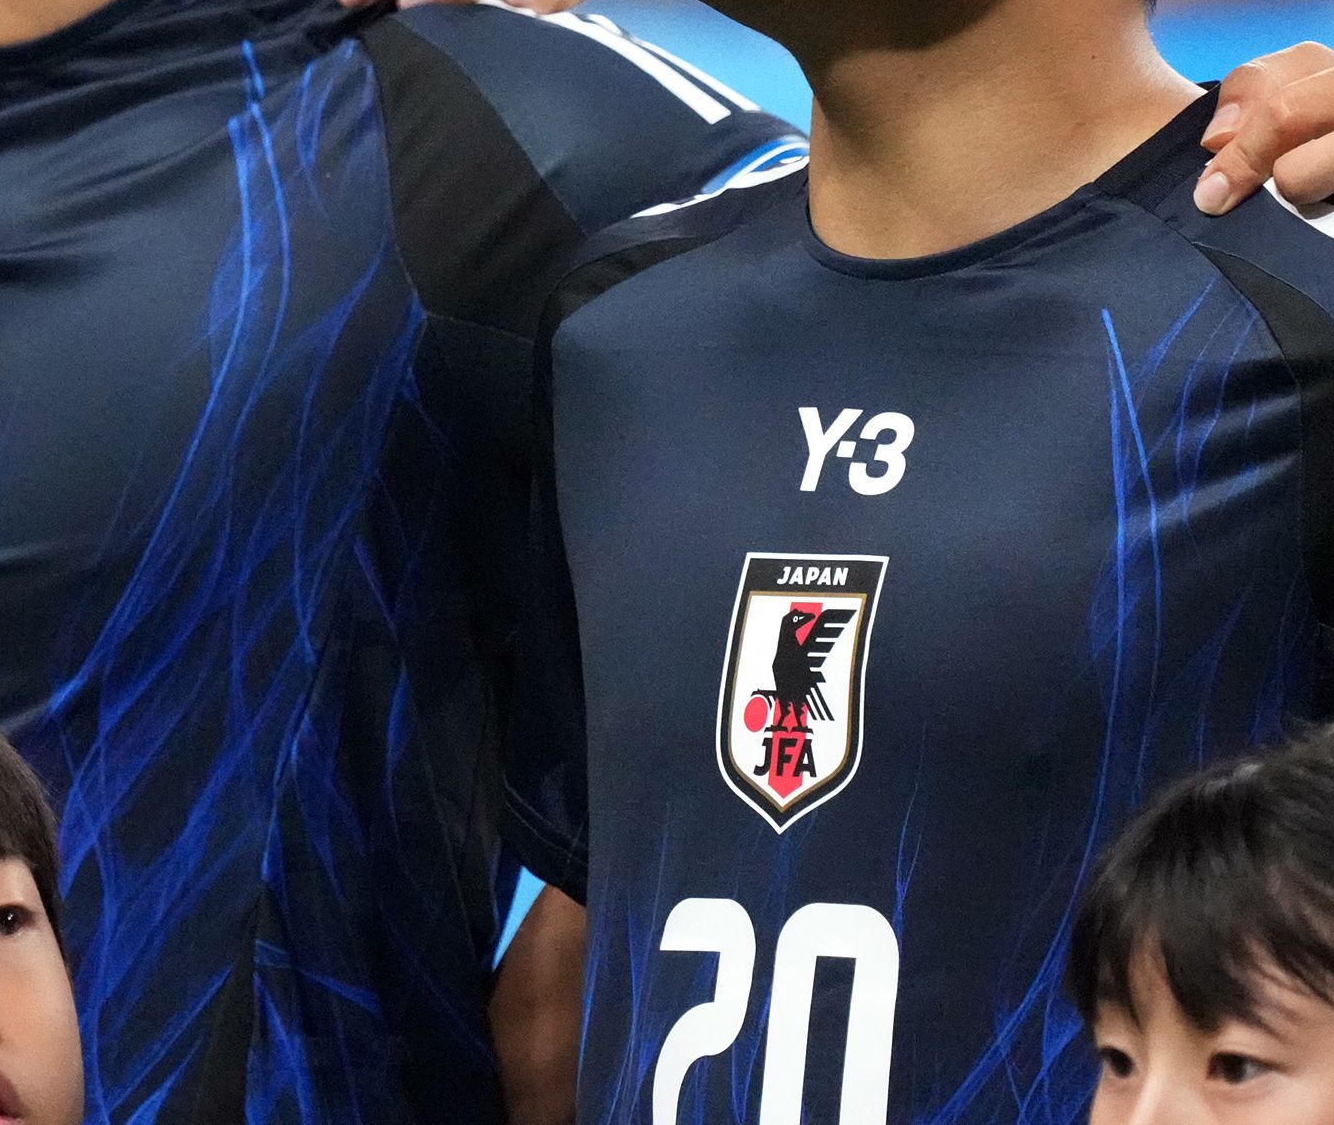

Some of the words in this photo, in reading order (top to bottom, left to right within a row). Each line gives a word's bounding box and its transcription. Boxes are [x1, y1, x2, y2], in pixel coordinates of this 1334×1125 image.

[798, 407, 916, 496] Y-3
[776, 566, 849, 586] JAPAN
[754, 738, 817, 779] JFA
[653, 898, 900, 1125] 20
